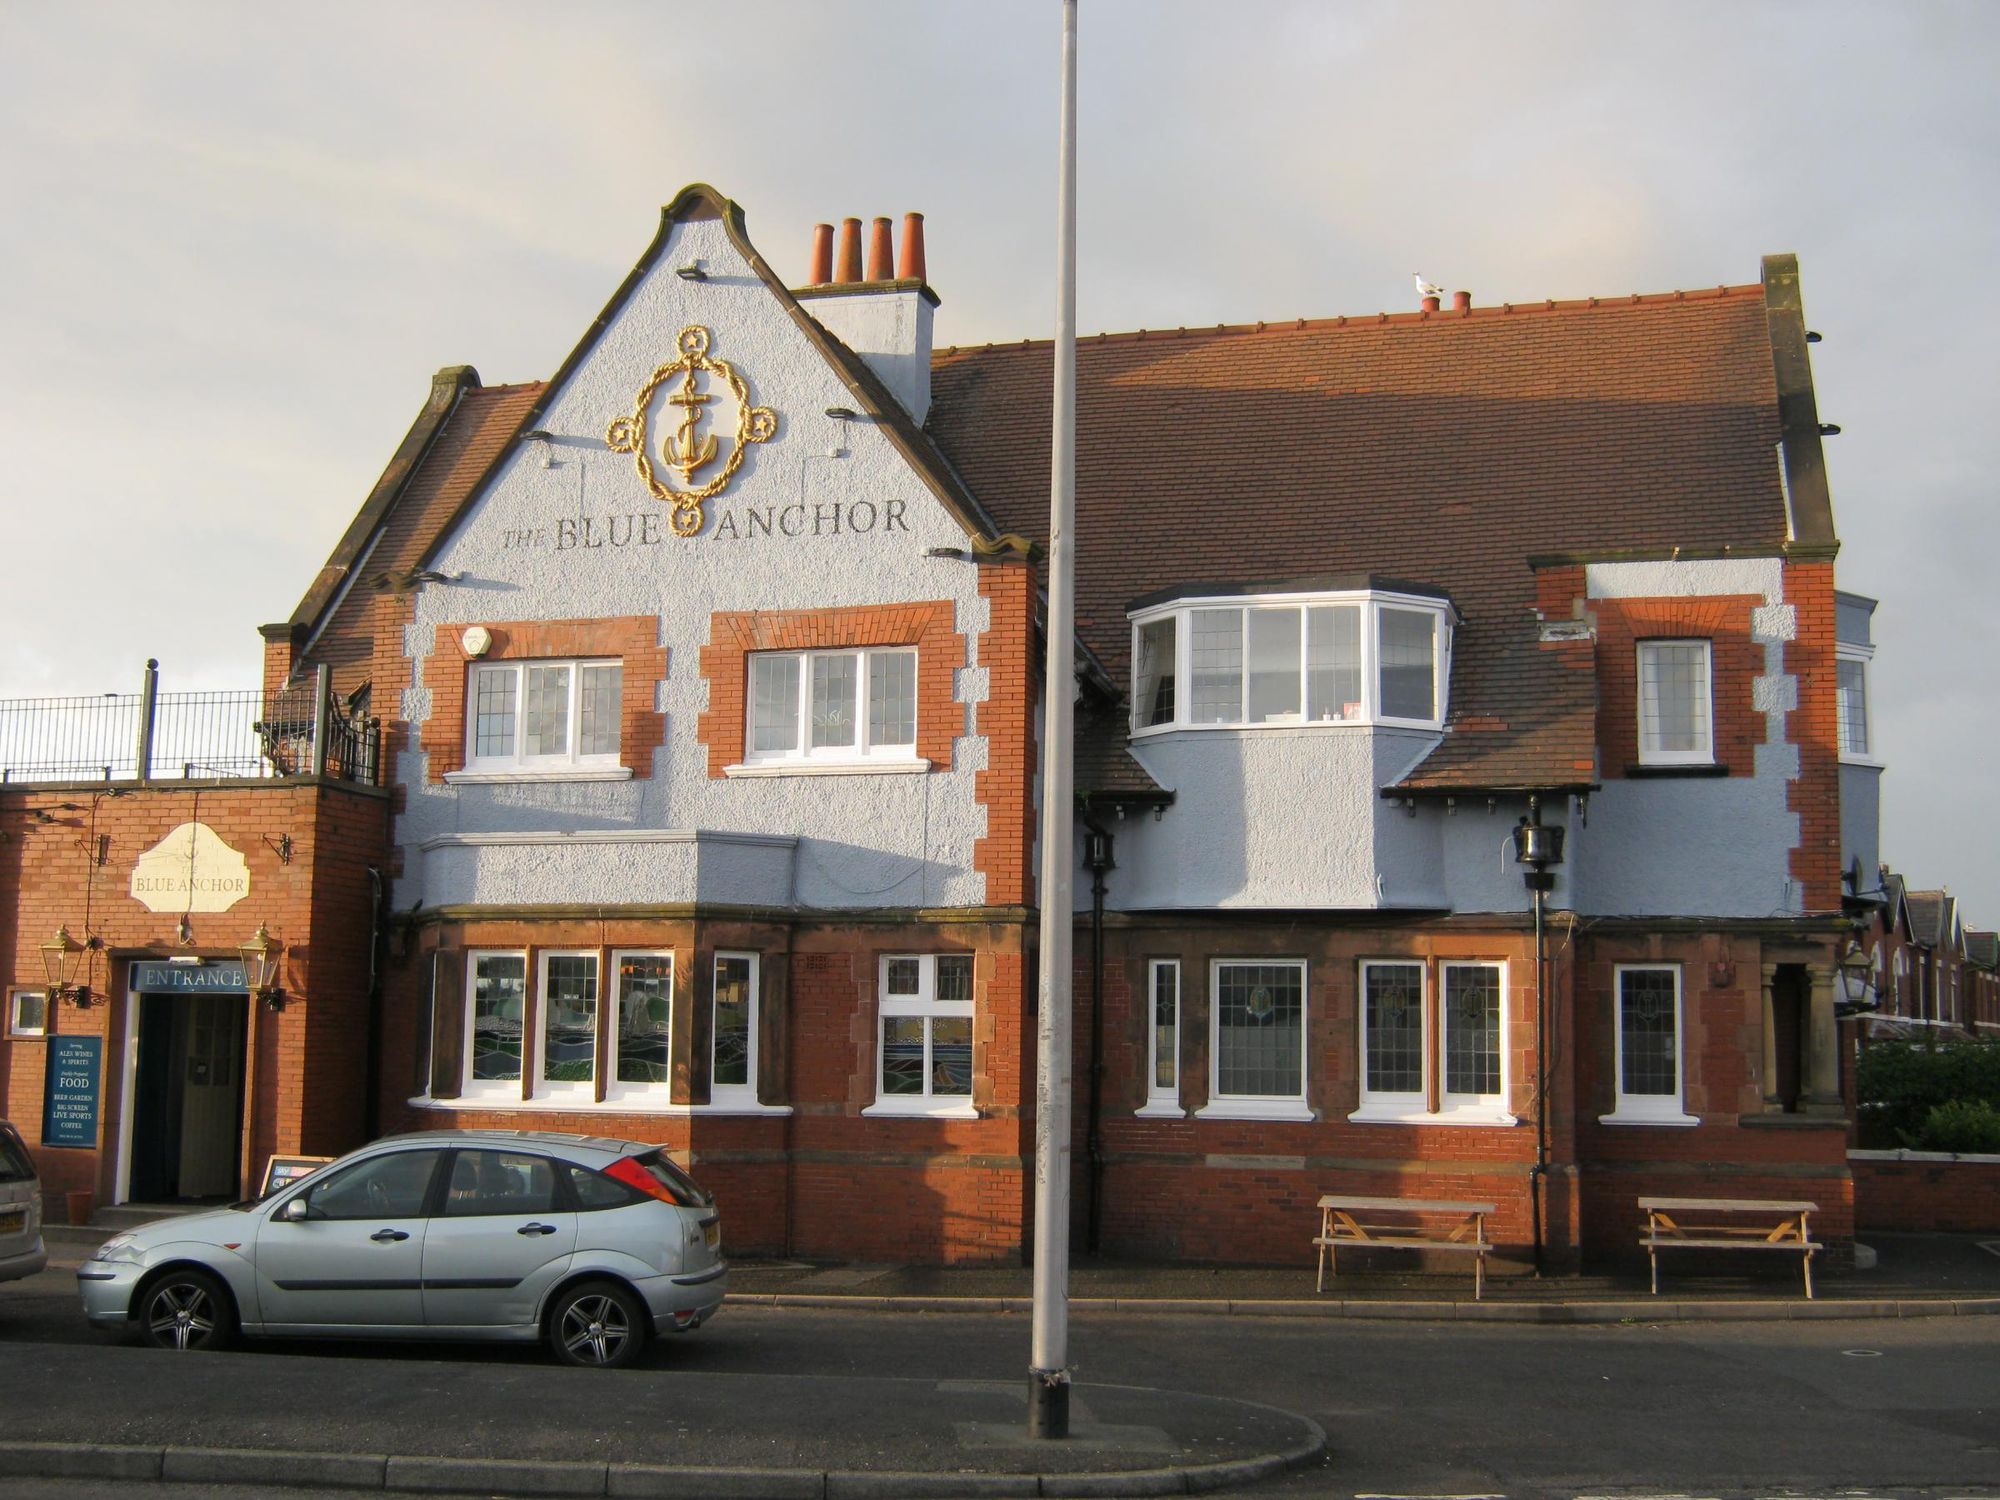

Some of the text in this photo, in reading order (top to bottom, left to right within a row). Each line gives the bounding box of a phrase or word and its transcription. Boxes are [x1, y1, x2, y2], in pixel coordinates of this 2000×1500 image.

[502, 499, 911, 550] THE BLUE ANCHOR
[136, 878, 244, 892] BLUE ANCHOR
[146, 969, 242, 986] ENTRANCE
[60, 1077, 89, 1088] FOOD
[69, 1112, 92, 1120] SPORTS
